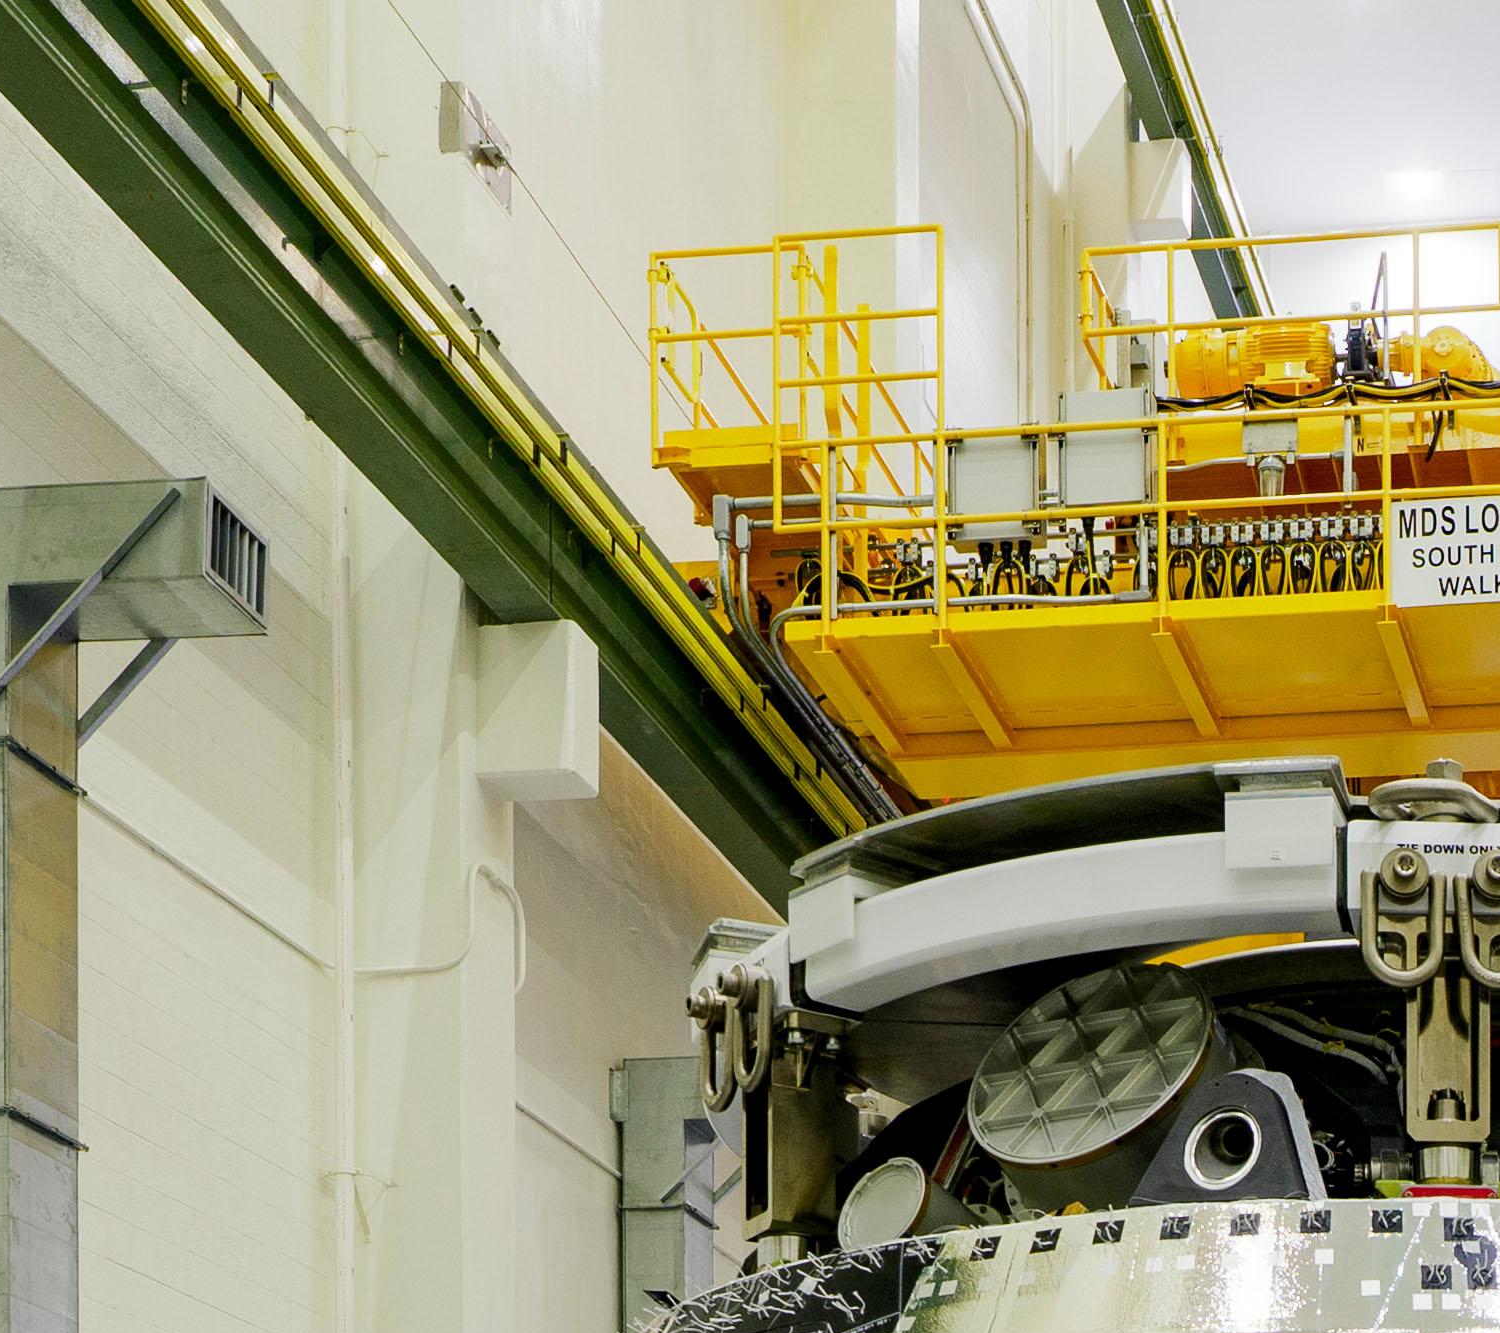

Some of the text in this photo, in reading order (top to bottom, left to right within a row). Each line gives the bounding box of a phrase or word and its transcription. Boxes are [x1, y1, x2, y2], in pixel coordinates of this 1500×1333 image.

[1357, 438, 1364, 451] N
[1399, 506, 1456, 539] MDS
[1412, 543, 1494, 568] SOUTH
[1424, 844, 1464, 854] DOWN
